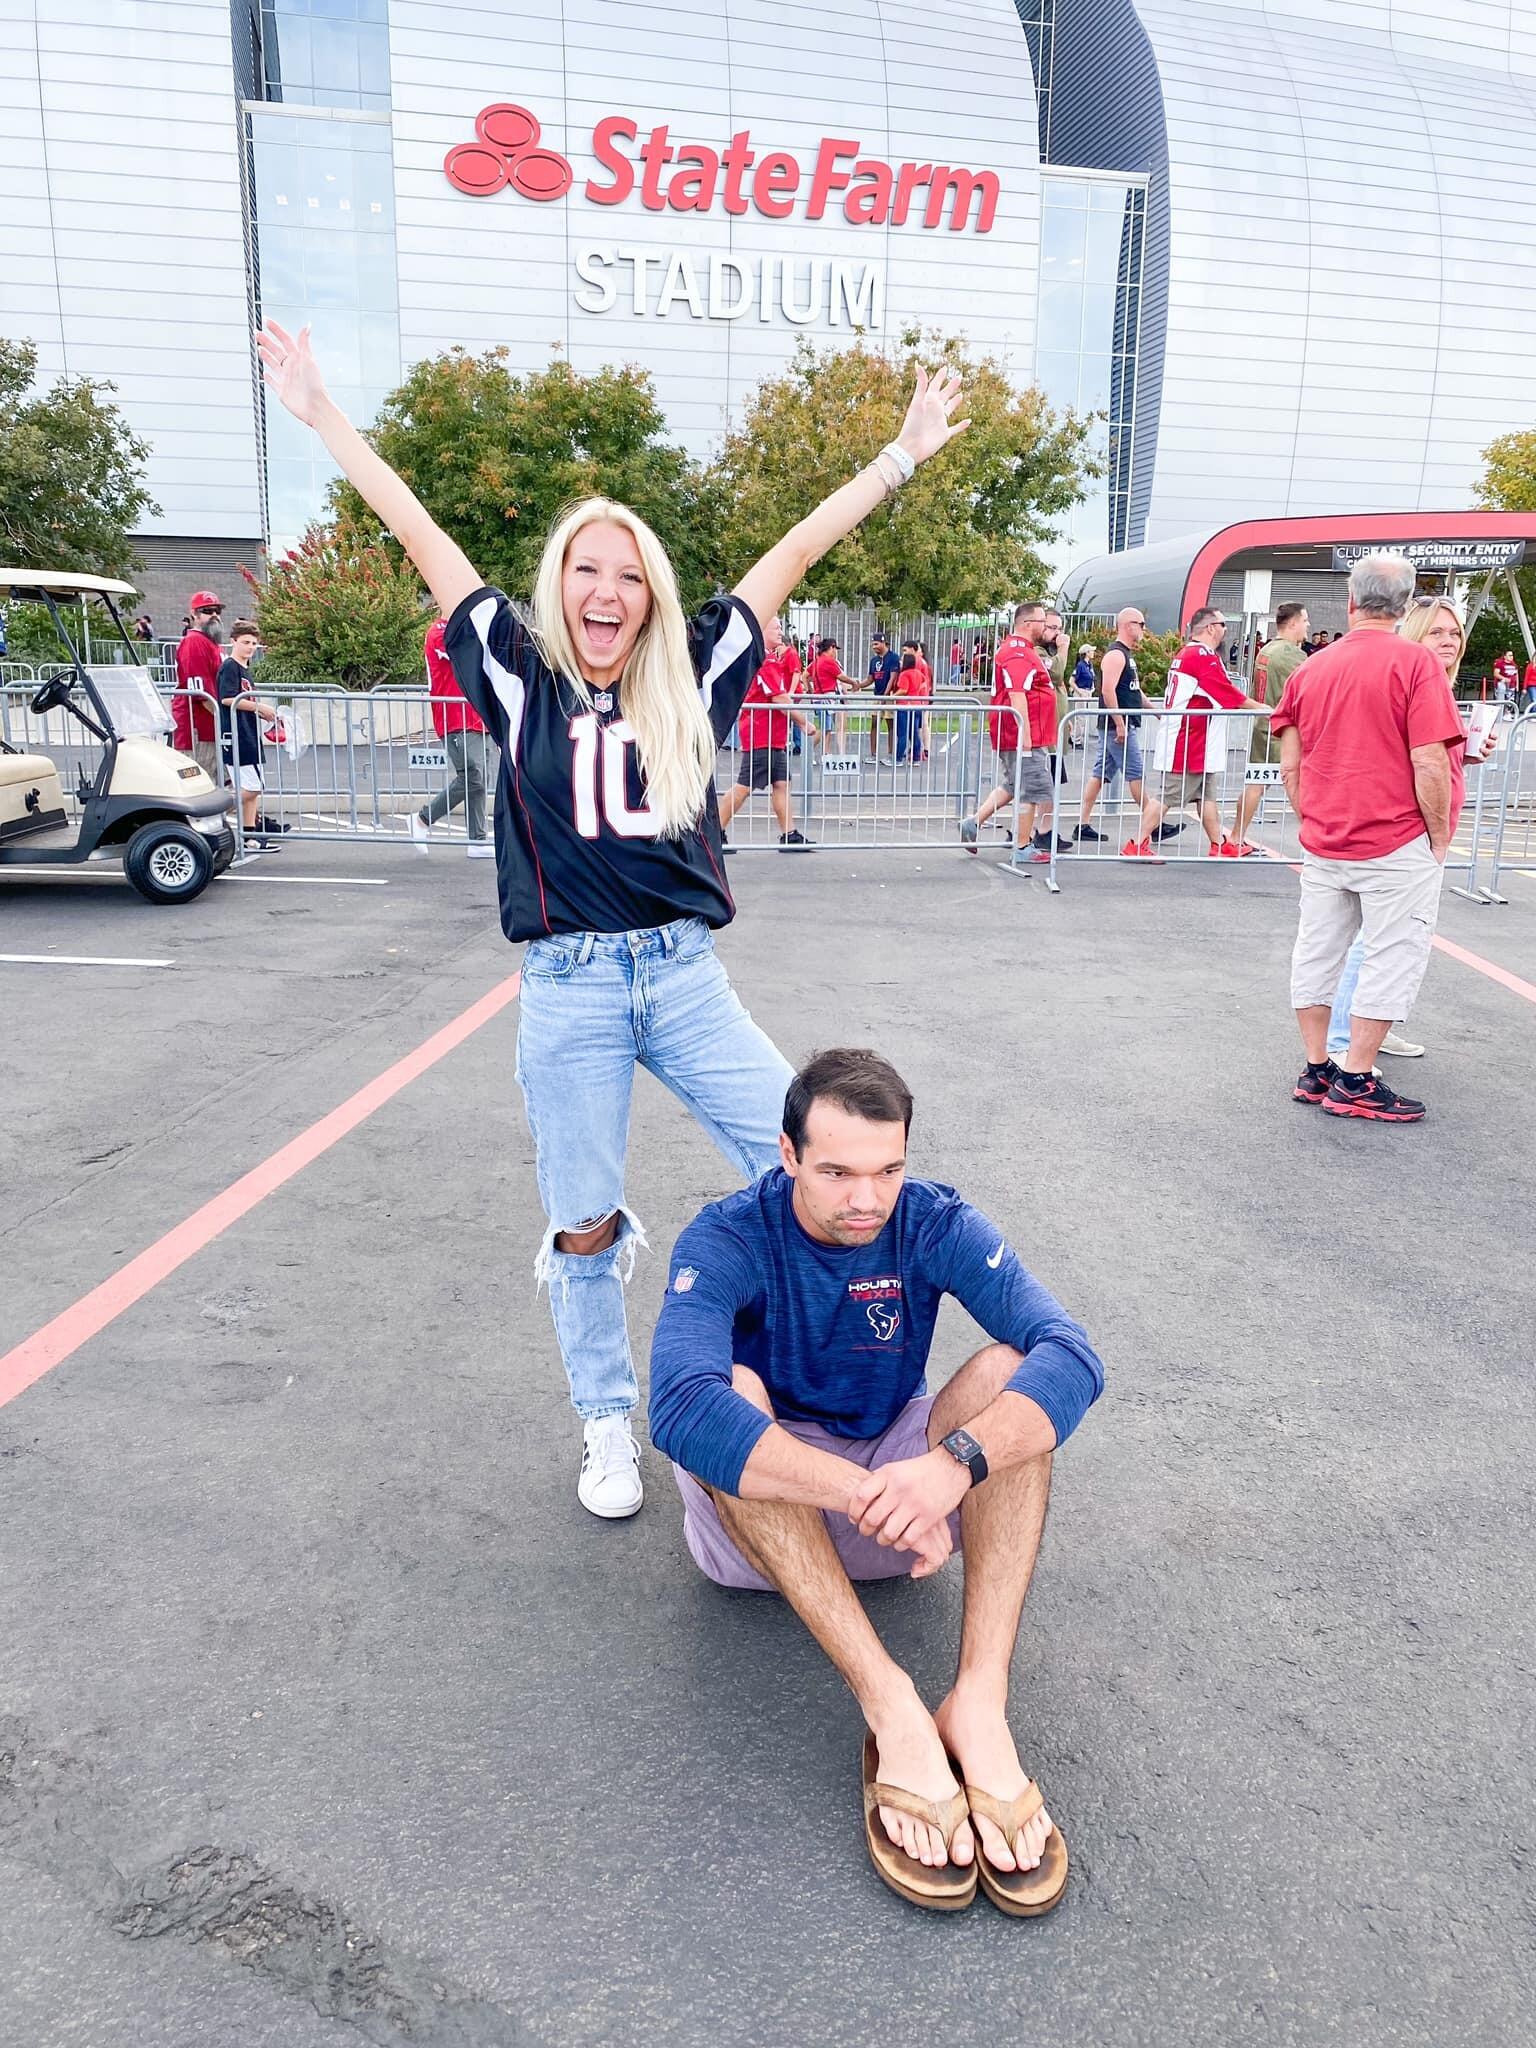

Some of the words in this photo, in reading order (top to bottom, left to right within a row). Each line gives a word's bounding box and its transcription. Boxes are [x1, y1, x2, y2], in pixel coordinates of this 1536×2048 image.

[585, 116, 800, 218] State
[805, 137, 1000, 233] Farm
[573, 247, 886, 328] STADIUM
[1408, 544, 1474, 556] SECURITY
[1475, 543, 1519, 555] ENTRY
[1430, 557, 1478, 566] MEMBERS
[1480, 556, 1508, 565] ONLY
[411, 755, 446, 765] AZSTA
[569, 713, 663, 839] 10
[1245, 770, 1280, 780] AZST
